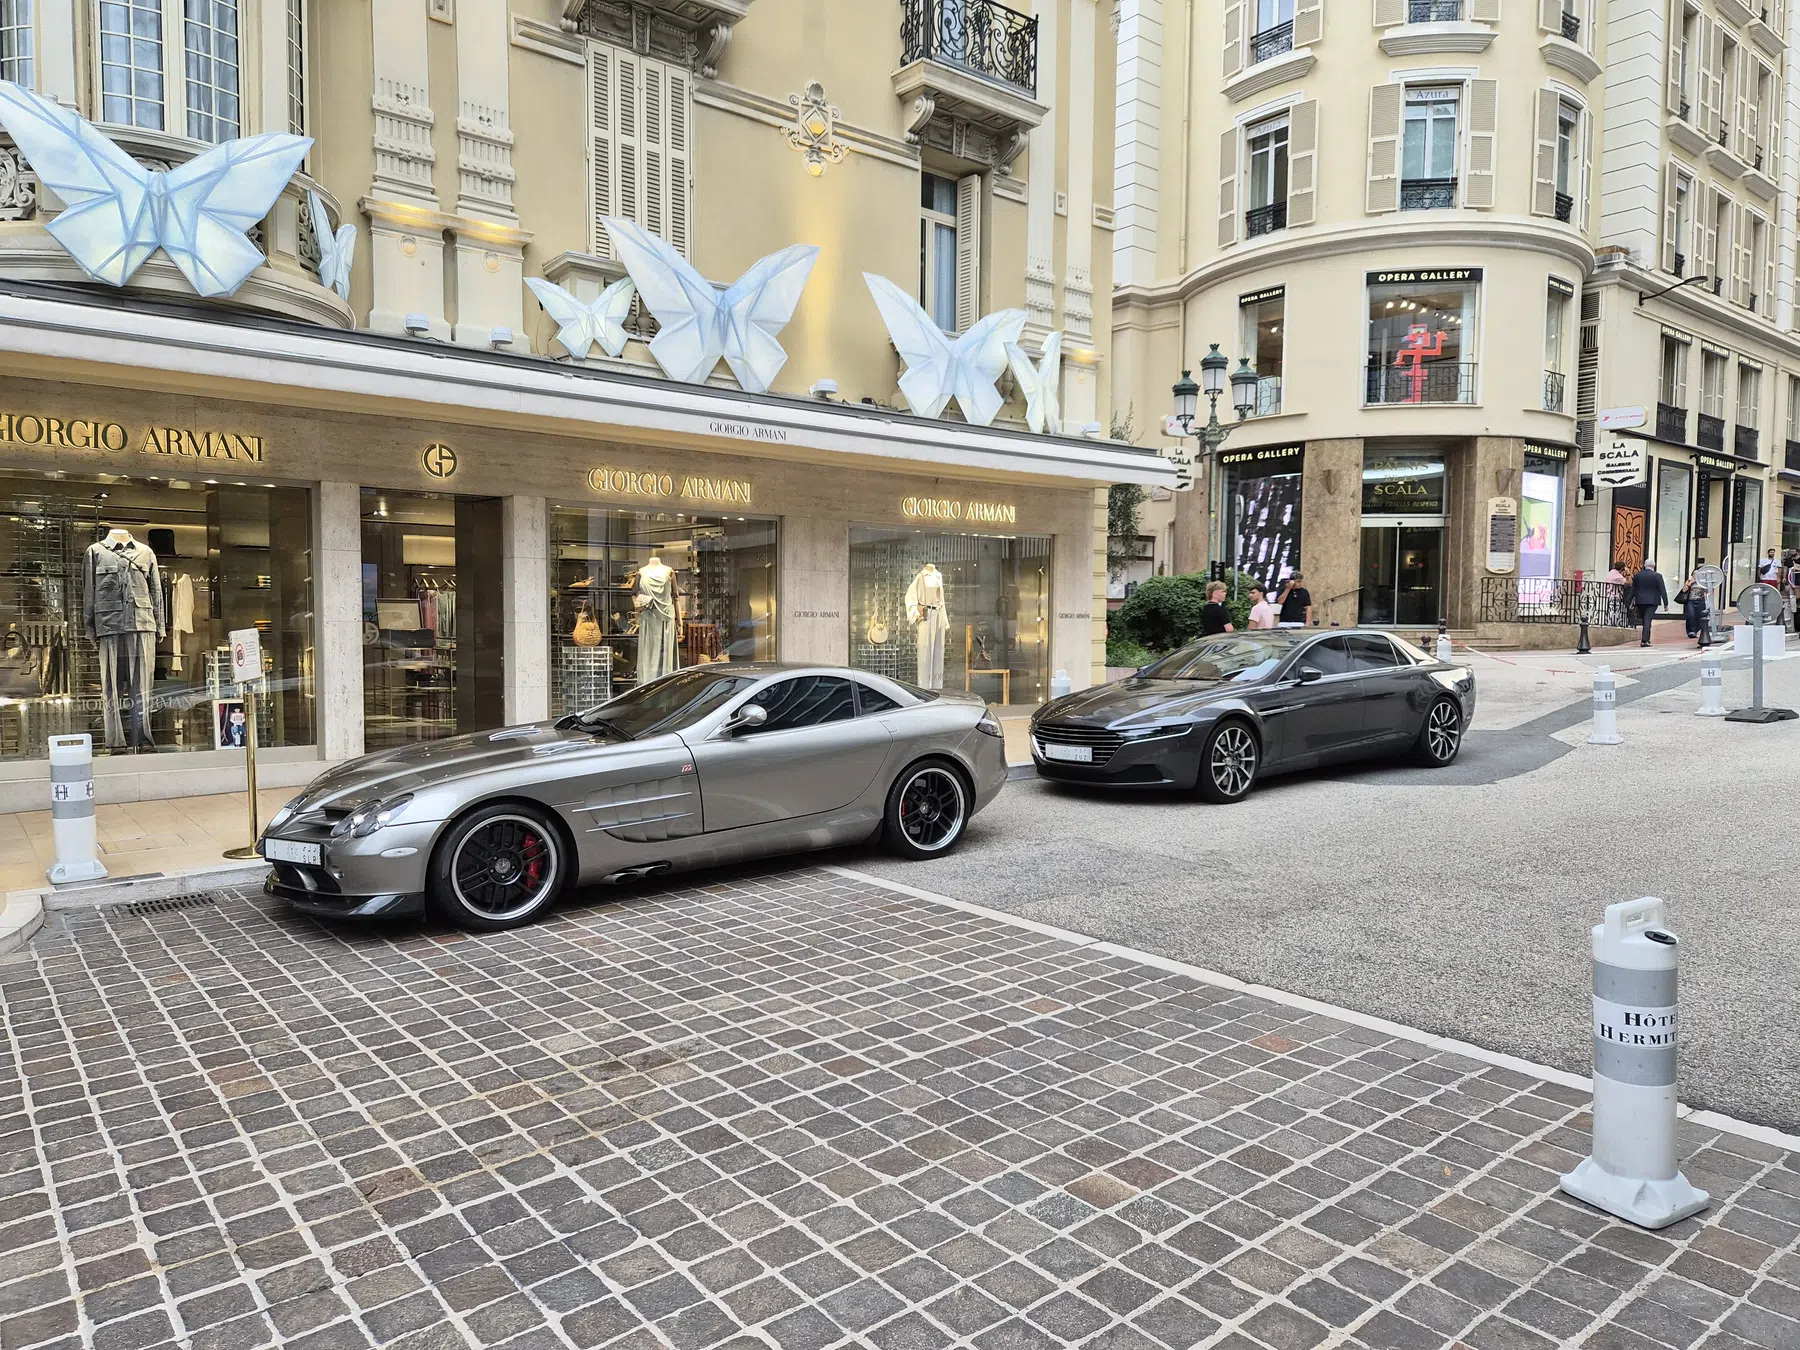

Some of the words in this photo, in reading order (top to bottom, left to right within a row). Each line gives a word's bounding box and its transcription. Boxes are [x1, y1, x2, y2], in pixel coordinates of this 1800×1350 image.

[1415, 89, 1449, 100] Azura
[1378, 273, 1416, 282] OPERA
[1420, 270, 1471, 280] GALLERY
[1259, 289, 1283, 299] GALLERY
[1662, 325, 1675, 336] OPERA
[1675, 330, 1692, 342] GALLERY
[0, 412, 129, 453] IORGIO
[139, 426, 264, 464] ARMANI
[709, 421, 749, 437] GIORGIO
[752, 427, 787, 441] ARMANI
[1174, 448, 1184, 456] LA
[1222, 454, 1253, 464] OPERA
[1257, 447, 1301, 460] GALLERY
[1523, 444, 1542, 454] OPERA
[1543, 447, 1568, 459] GALLERY
[1599, 450, 1639, 460] SCALA
[1700, 455, 1715, 465] OPERA
[1716, 459, 1735, 470] GALLERY
[587, 467, 674, 498] GIORGIO
[680, 475, 752, 504] ARMANI
[1373, 485, 1429, 495] SCALA
[901, 496, 961, 520] GIORGIO
[965, 502, 1016, 524] ARMANI
[71, 697, 135, 711] GIORGIO
[302, 854, 317, 863] SLR
[1624, 1012, 1678, 1028] HÔTE
